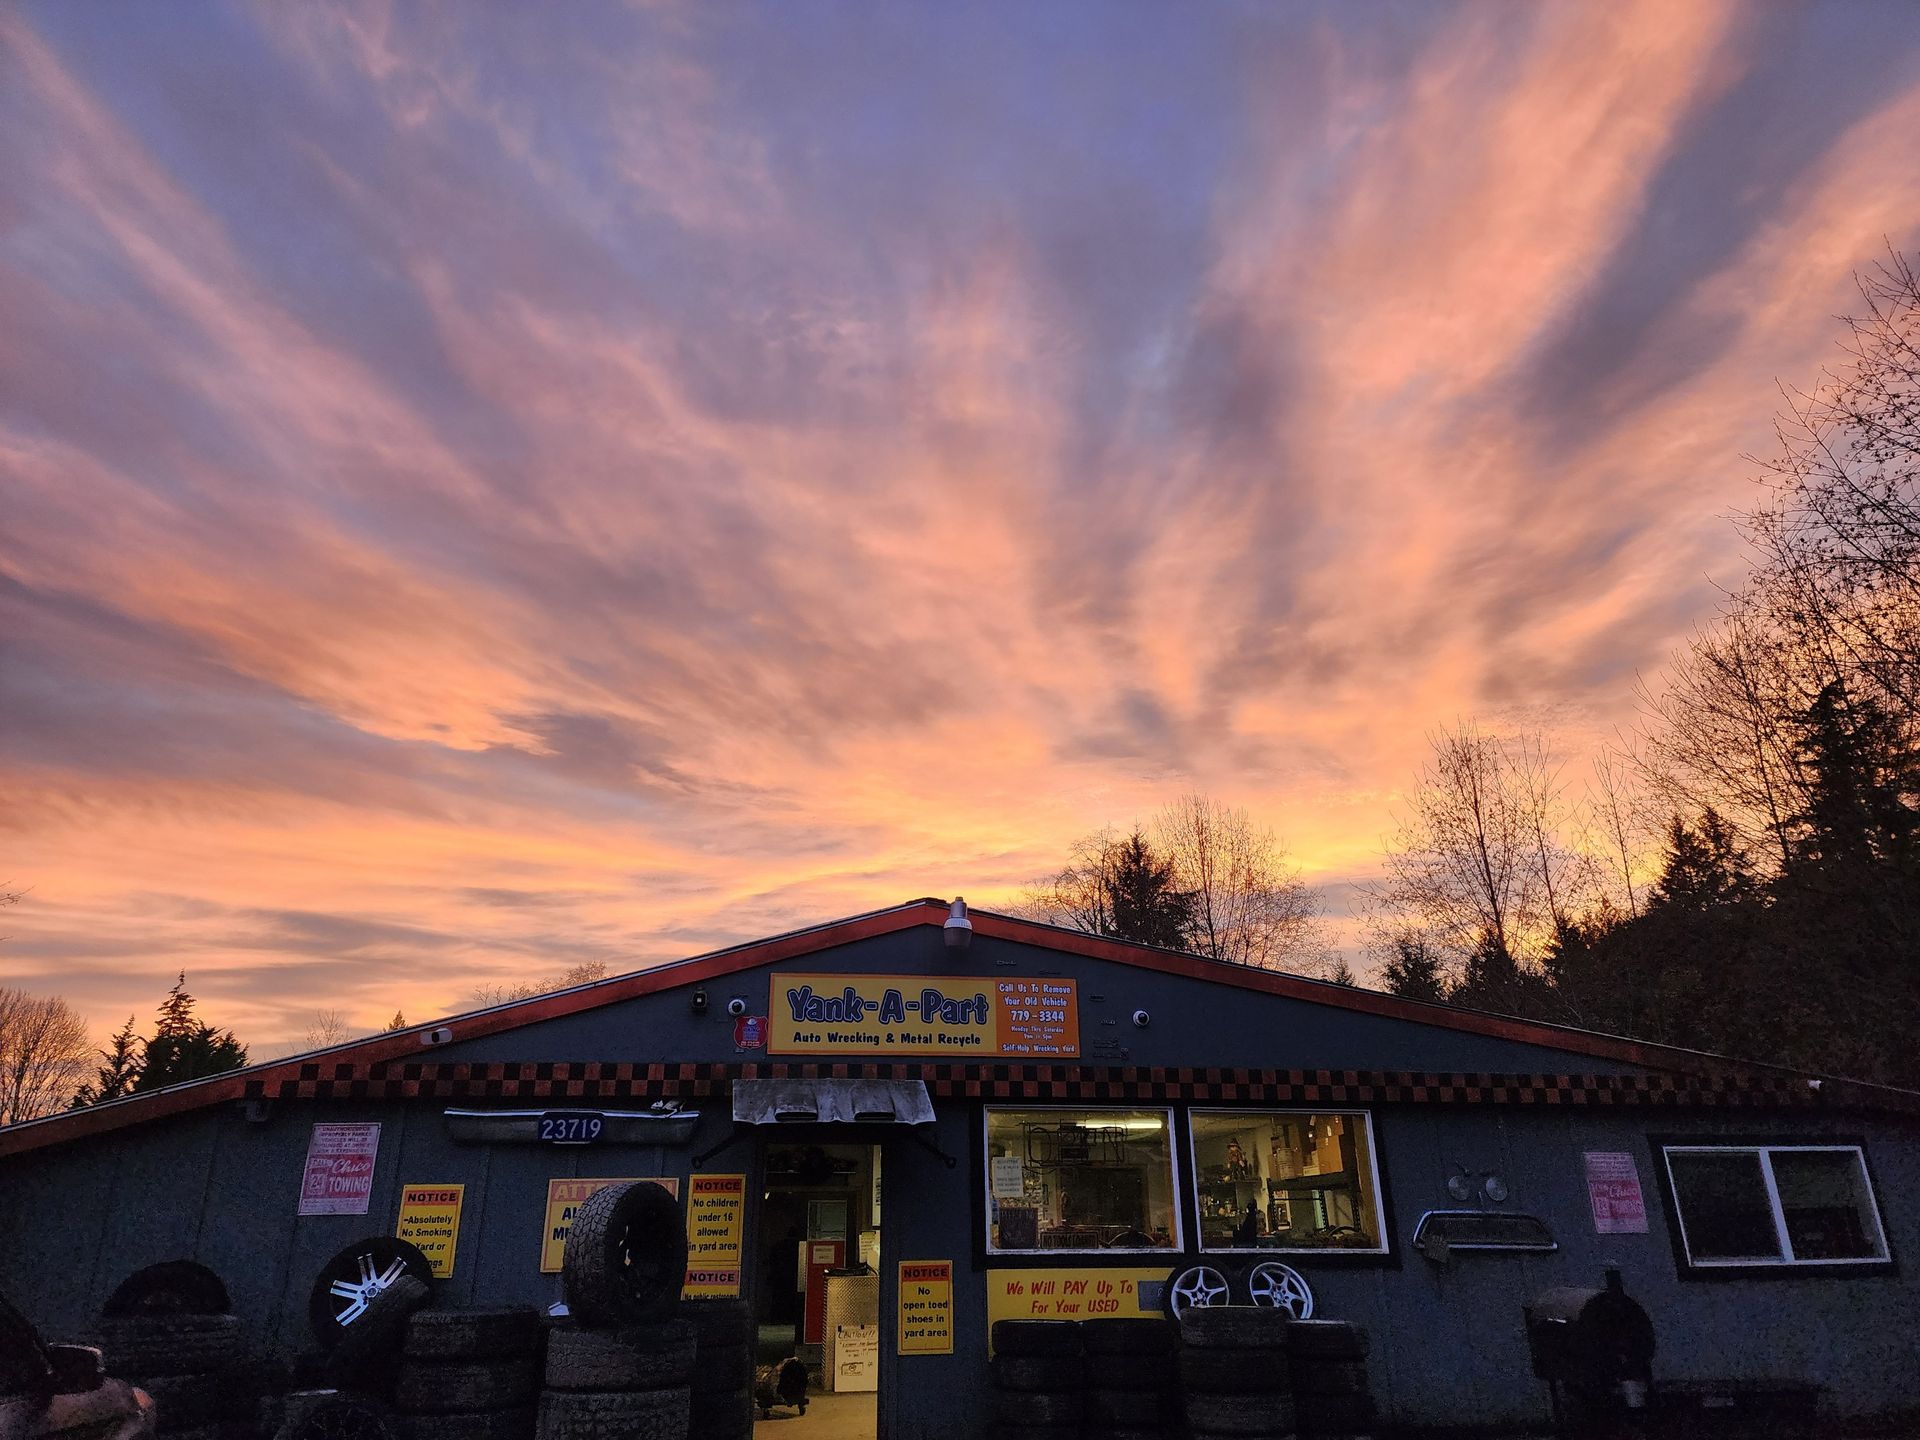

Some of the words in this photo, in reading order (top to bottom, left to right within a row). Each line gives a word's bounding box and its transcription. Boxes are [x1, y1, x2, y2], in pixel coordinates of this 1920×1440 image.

[999, 983, 1014, 993] Call
[1017, 983, 1027, 993] Us
[1031, 984, 1039, 993] To
[1043, 984, 1071, 994] Remove
[787, 985, 989, 1025] Yank-A-Part
[1004, 996, 1020, 1006] Your
[1024, 996, 1038, 1006] Old
[1042, 997, 1067, 1007] Vehicle
[794, 1032, 821, 1043] Auto
[828, 1032, 880, 1046] Wrecking
[886, 1033, 896, 1043] &
[901, 1033, 932, 1044] Metal
[938, 1033, 982, 1047] Recycle
[1034, 1044, 1059, 1054] Wrecking
[1062, 1045, 1075, 1053] Yard
[542, 1118, 602, 1140] 23719
[329, 1176, 370, 1193] TOWING
[695, 1181, 741, 1191] NOTICE
[407, 1193, 456, 1202] NOTICE
[693, 1199, 704, 1207] No
[707, 1198, 739, 1207] children
[698, 1212, 721, 1221] under
[724, 1213, 733, 1221] 16
[402, 1229, 413, 1237] No
[416, 1228, 452, 1238] Smoking
[697, 1227, 729, 1236] allowed
[689, 1242, 697, 1250] in
[699, 1242, 717, 1252] yard
[689, 1273, 735, 1282] NOTICE
[904, 1269, 948, 1278] NOTICE
[918, 1287, 931, 1295] No
[1006, 1280, 1024, 1295] We
[1031, 1280, 1055, 1295] Will
[1063, 1279, 1089, 1295] PAY
[1096, 1280, 1114, 1297] Up
[1120, 1279, 1133, 1294] To
[903, 1302, 925, 1311] open
[928, 1301, 948, 1309] toed
[1031, 1301, 1049, 1313] For
[1055, 1299, 1081, 1313] Your
[1088, 1299, 1119, 1313] USED
[907, 1314, 933, 1323] shoes
[936, 1314, 945, 1322] in
[904, 1329, 925, 1339] yard
